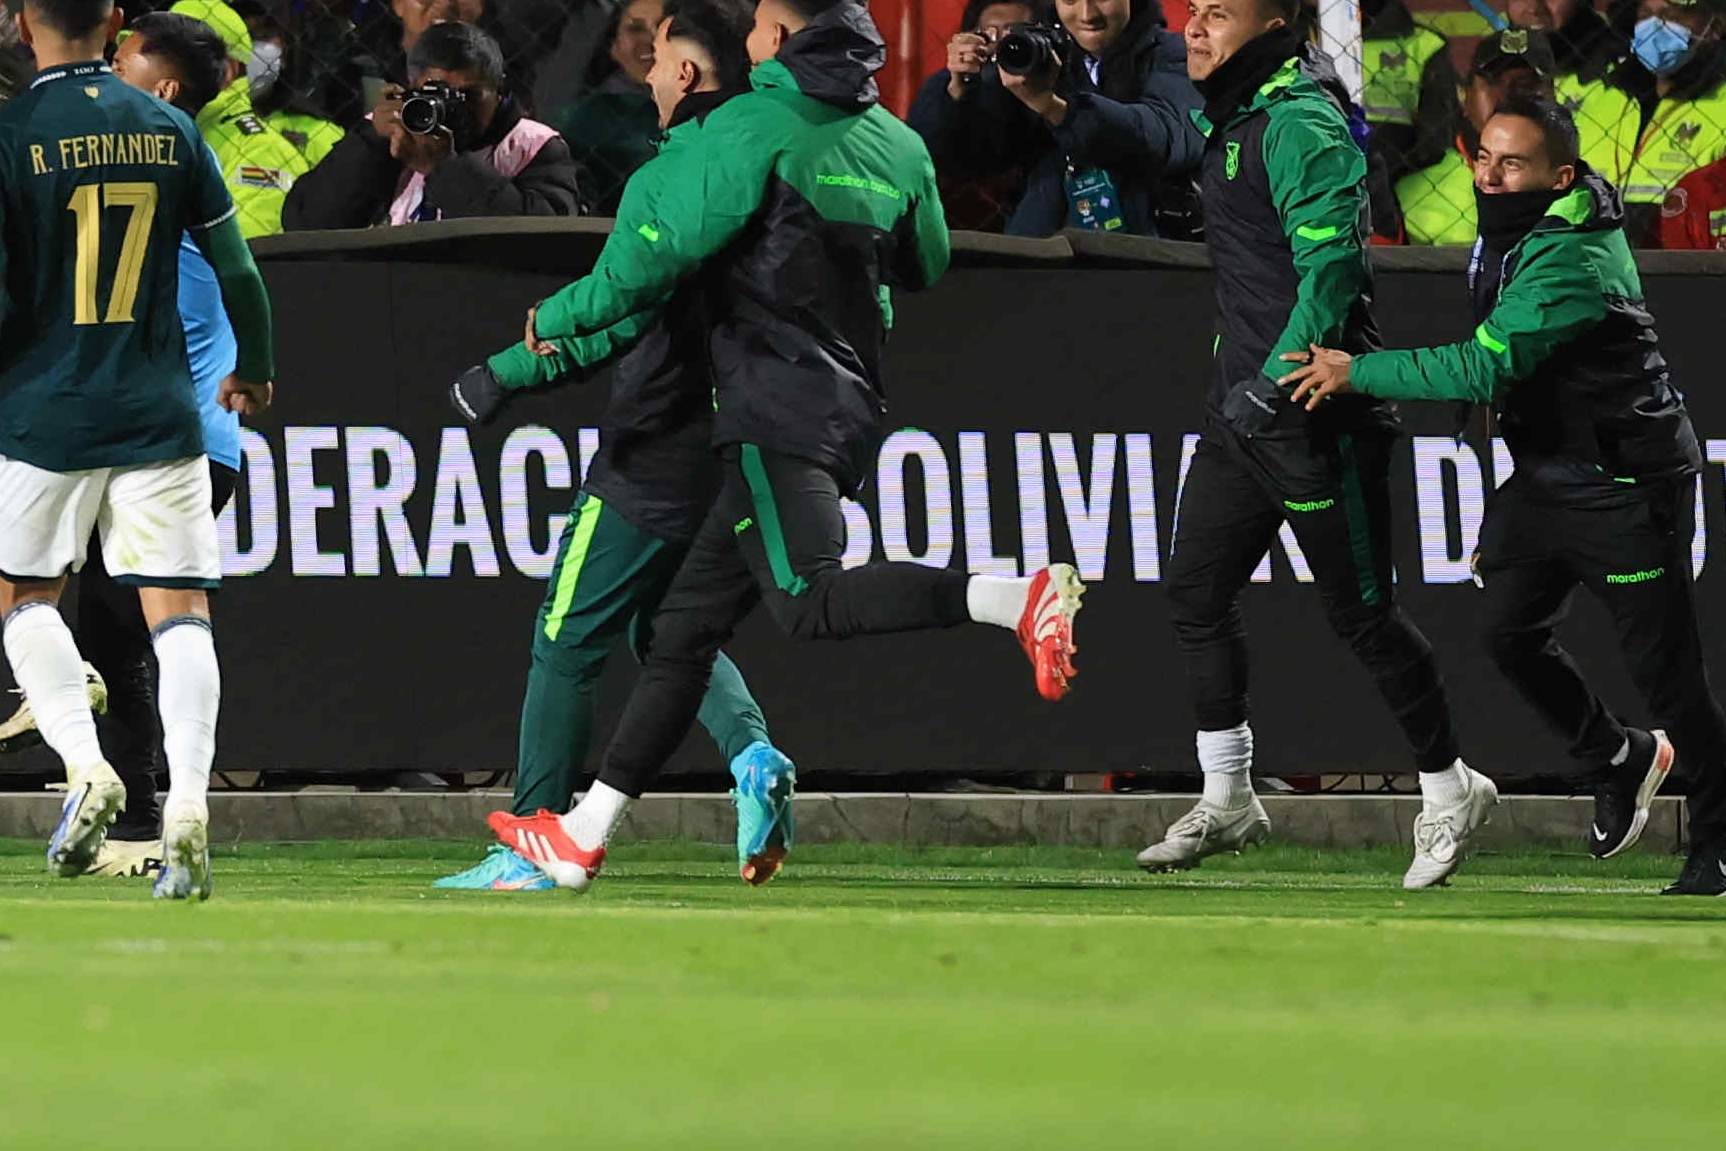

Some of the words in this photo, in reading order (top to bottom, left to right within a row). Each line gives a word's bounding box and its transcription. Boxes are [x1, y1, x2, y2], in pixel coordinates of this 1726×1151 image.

[29, 144, 54, 175] R.
[58, 133, 179, 170] FERNANDEZ
[66, 182, 159, 325] 17
[217, 426, 600, 579] DERAC
[1284, 498, 1335, 512] marathon
[1606, 566, 1665, 585] marathon
